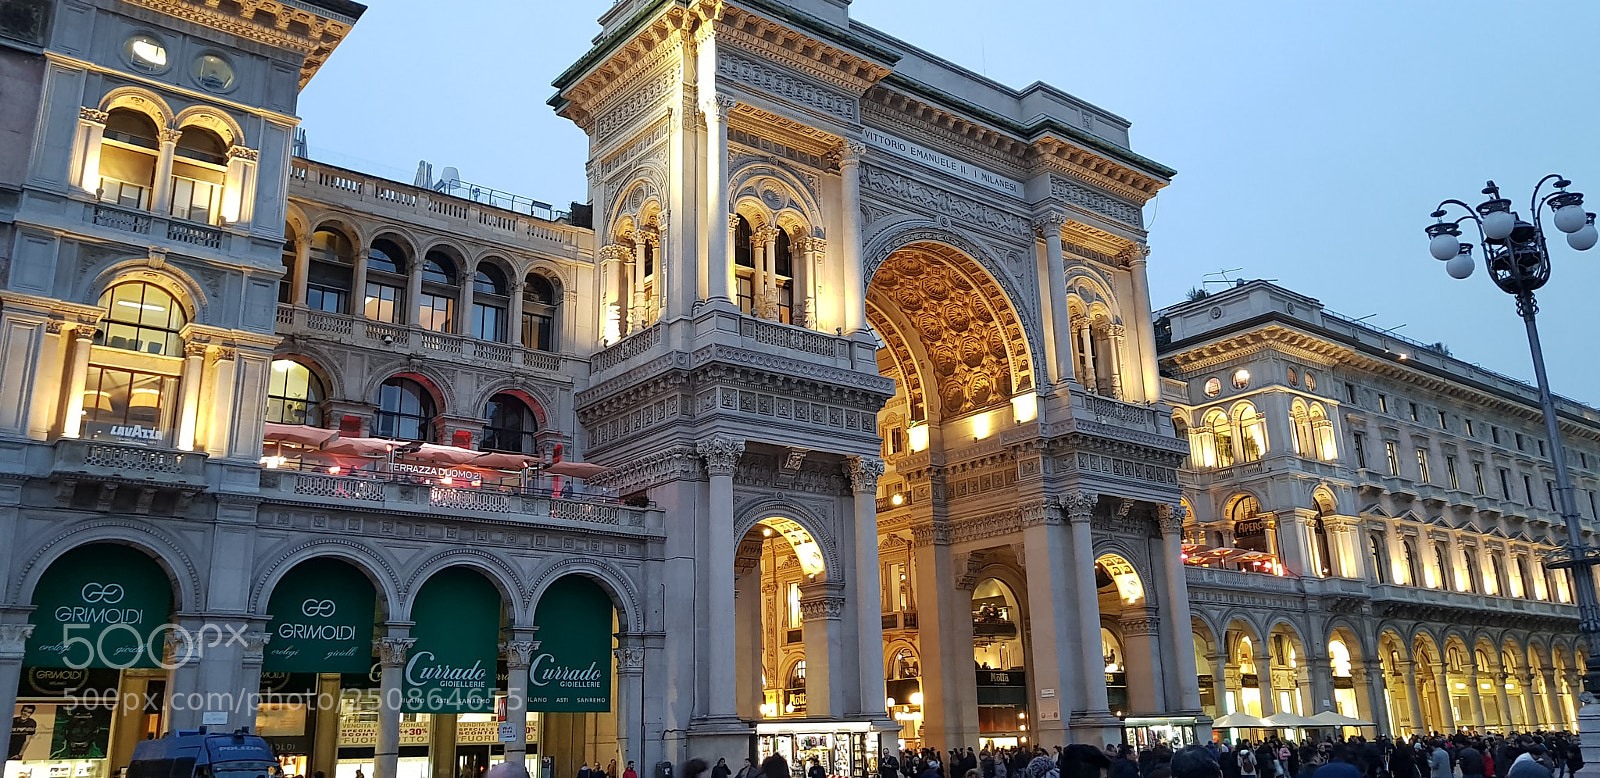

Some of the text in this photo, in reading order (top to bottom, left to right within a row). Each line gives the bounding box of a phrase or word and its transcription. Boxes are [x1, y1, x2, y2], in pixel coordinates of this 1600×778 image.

[864, 129, 906, 152] VITTORIO
[910, 146, 957, 171] EMANUELE
[981, 172, 1017, 193] MILANESI
[110, 424, 162, 440] LAVAZZA
[389, 462, 437, 475] TERRAZZA
[438, 468, 473, 479] DUOMO
[55, 606, 143, 624] GRIMOLDI
[278, 623, 356, 640] GRIMOLDI
[36, 670, 82, 679] GRIMOLDI
[405, 651, 487, 687] Currado
[529, 653, 601, 687] Currado
[440, 680, 485, 688] GIOIELLERIE
